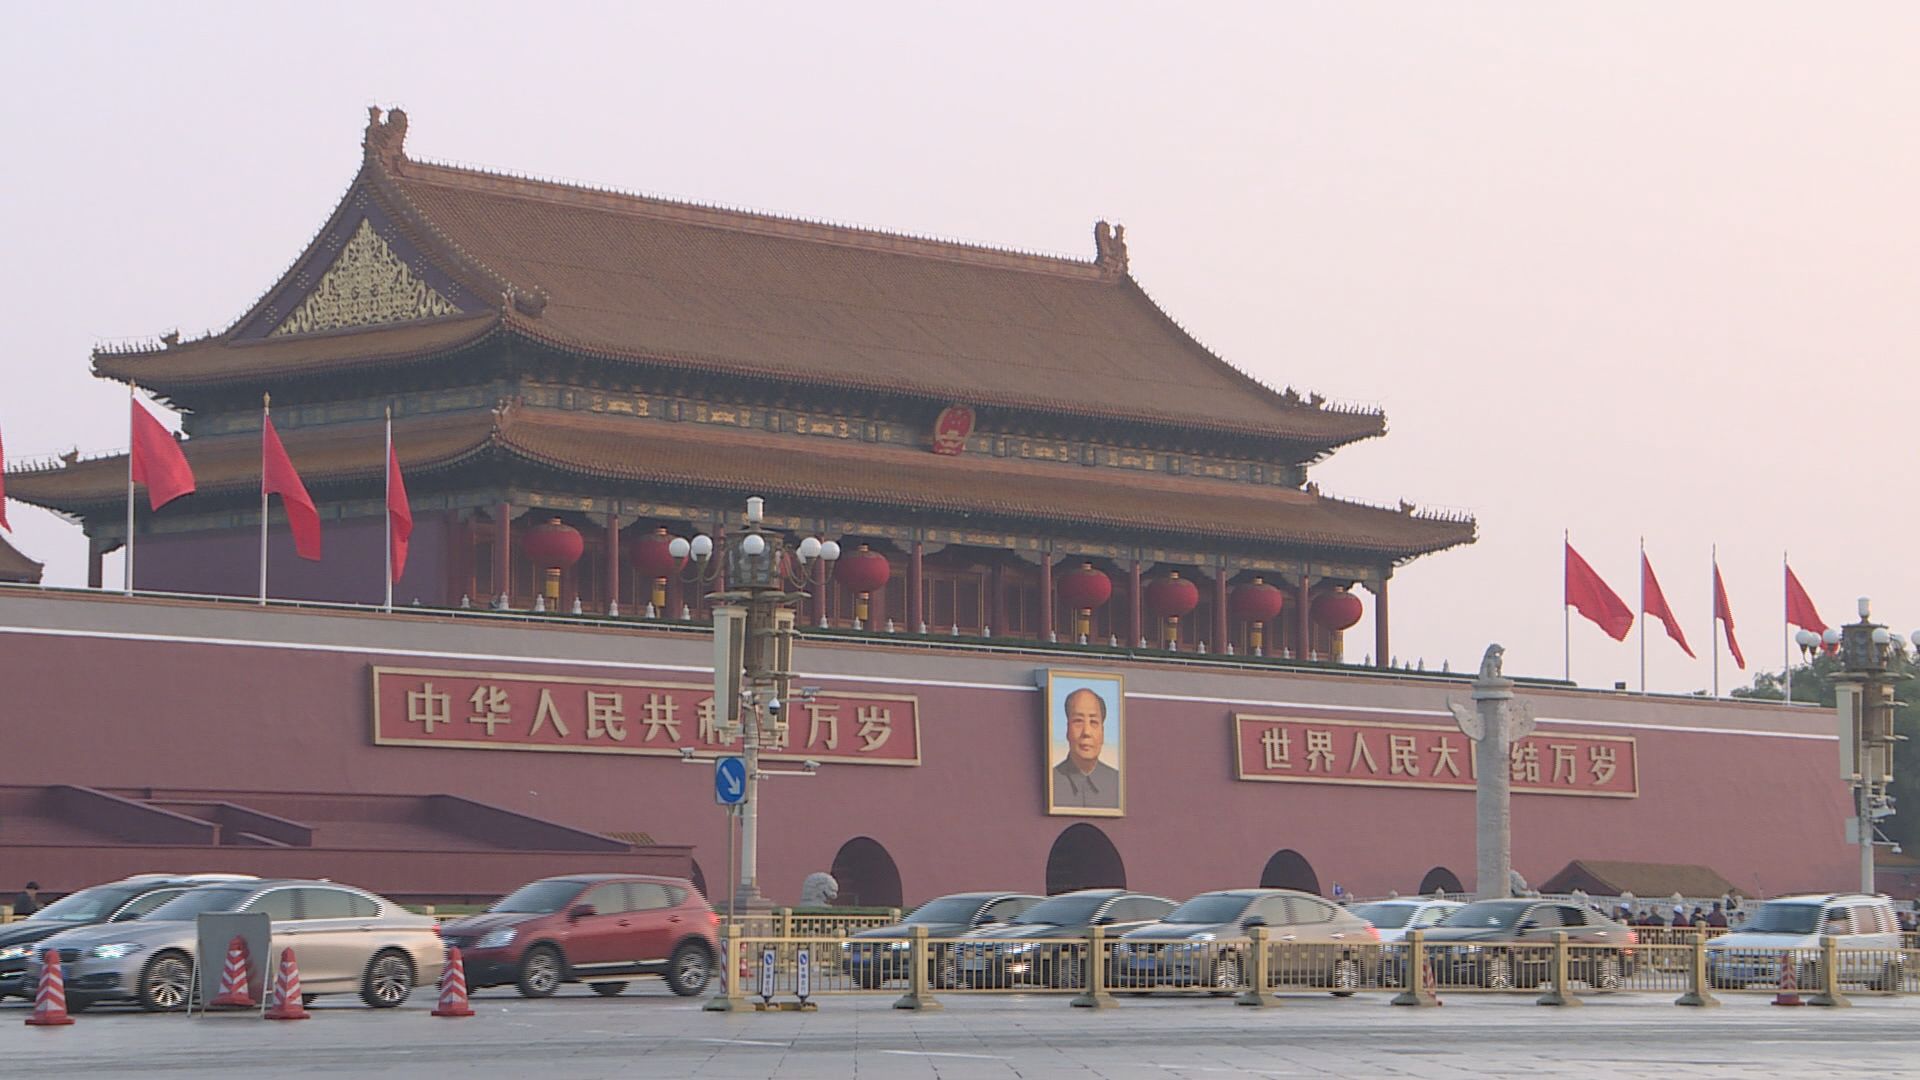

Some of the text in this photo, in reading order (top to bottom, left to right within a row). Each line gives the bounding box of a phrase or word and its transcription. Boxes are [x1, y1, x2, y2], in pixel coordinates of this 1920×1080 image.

[1260, 727, 1617, 785] 世界人民大结万岁
